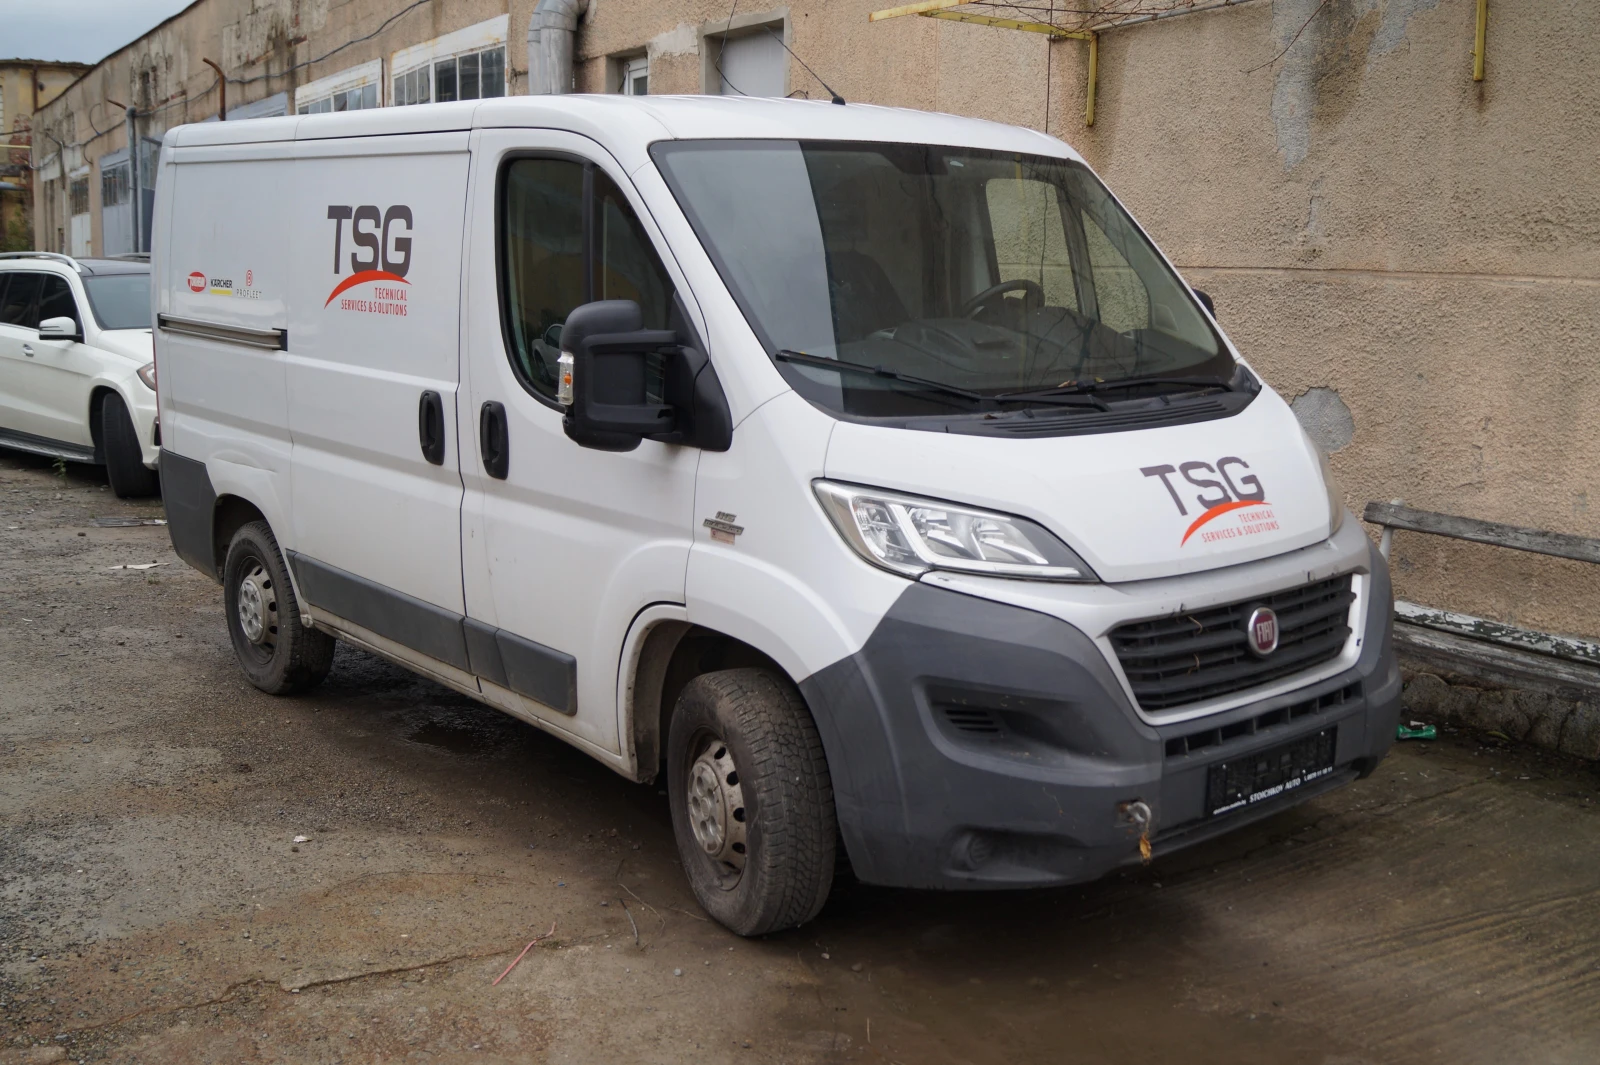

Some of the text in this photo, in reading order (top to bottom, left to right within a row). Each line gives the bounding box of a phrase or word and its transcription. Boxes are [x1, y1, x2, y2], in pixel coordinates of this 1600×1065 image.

[326, 204, 413, 279] TSG
[374, 287, 408, 301] TECHNICAL
[341, 299, 367, 312] SERVICES
[373, 301, 408, 317] SOLUTIONS
[1139, 456, 1265, 516] TSG
[1238, 509, 1275, 524] TECHNICAL
[1201, 527, 1236, 543] SERVICES
[1243, 520, 1280, 536] SOLUTIONS
[1256, 619, 1274, 645] FIAT
[1284, 777, 1301, 791] AUTO
